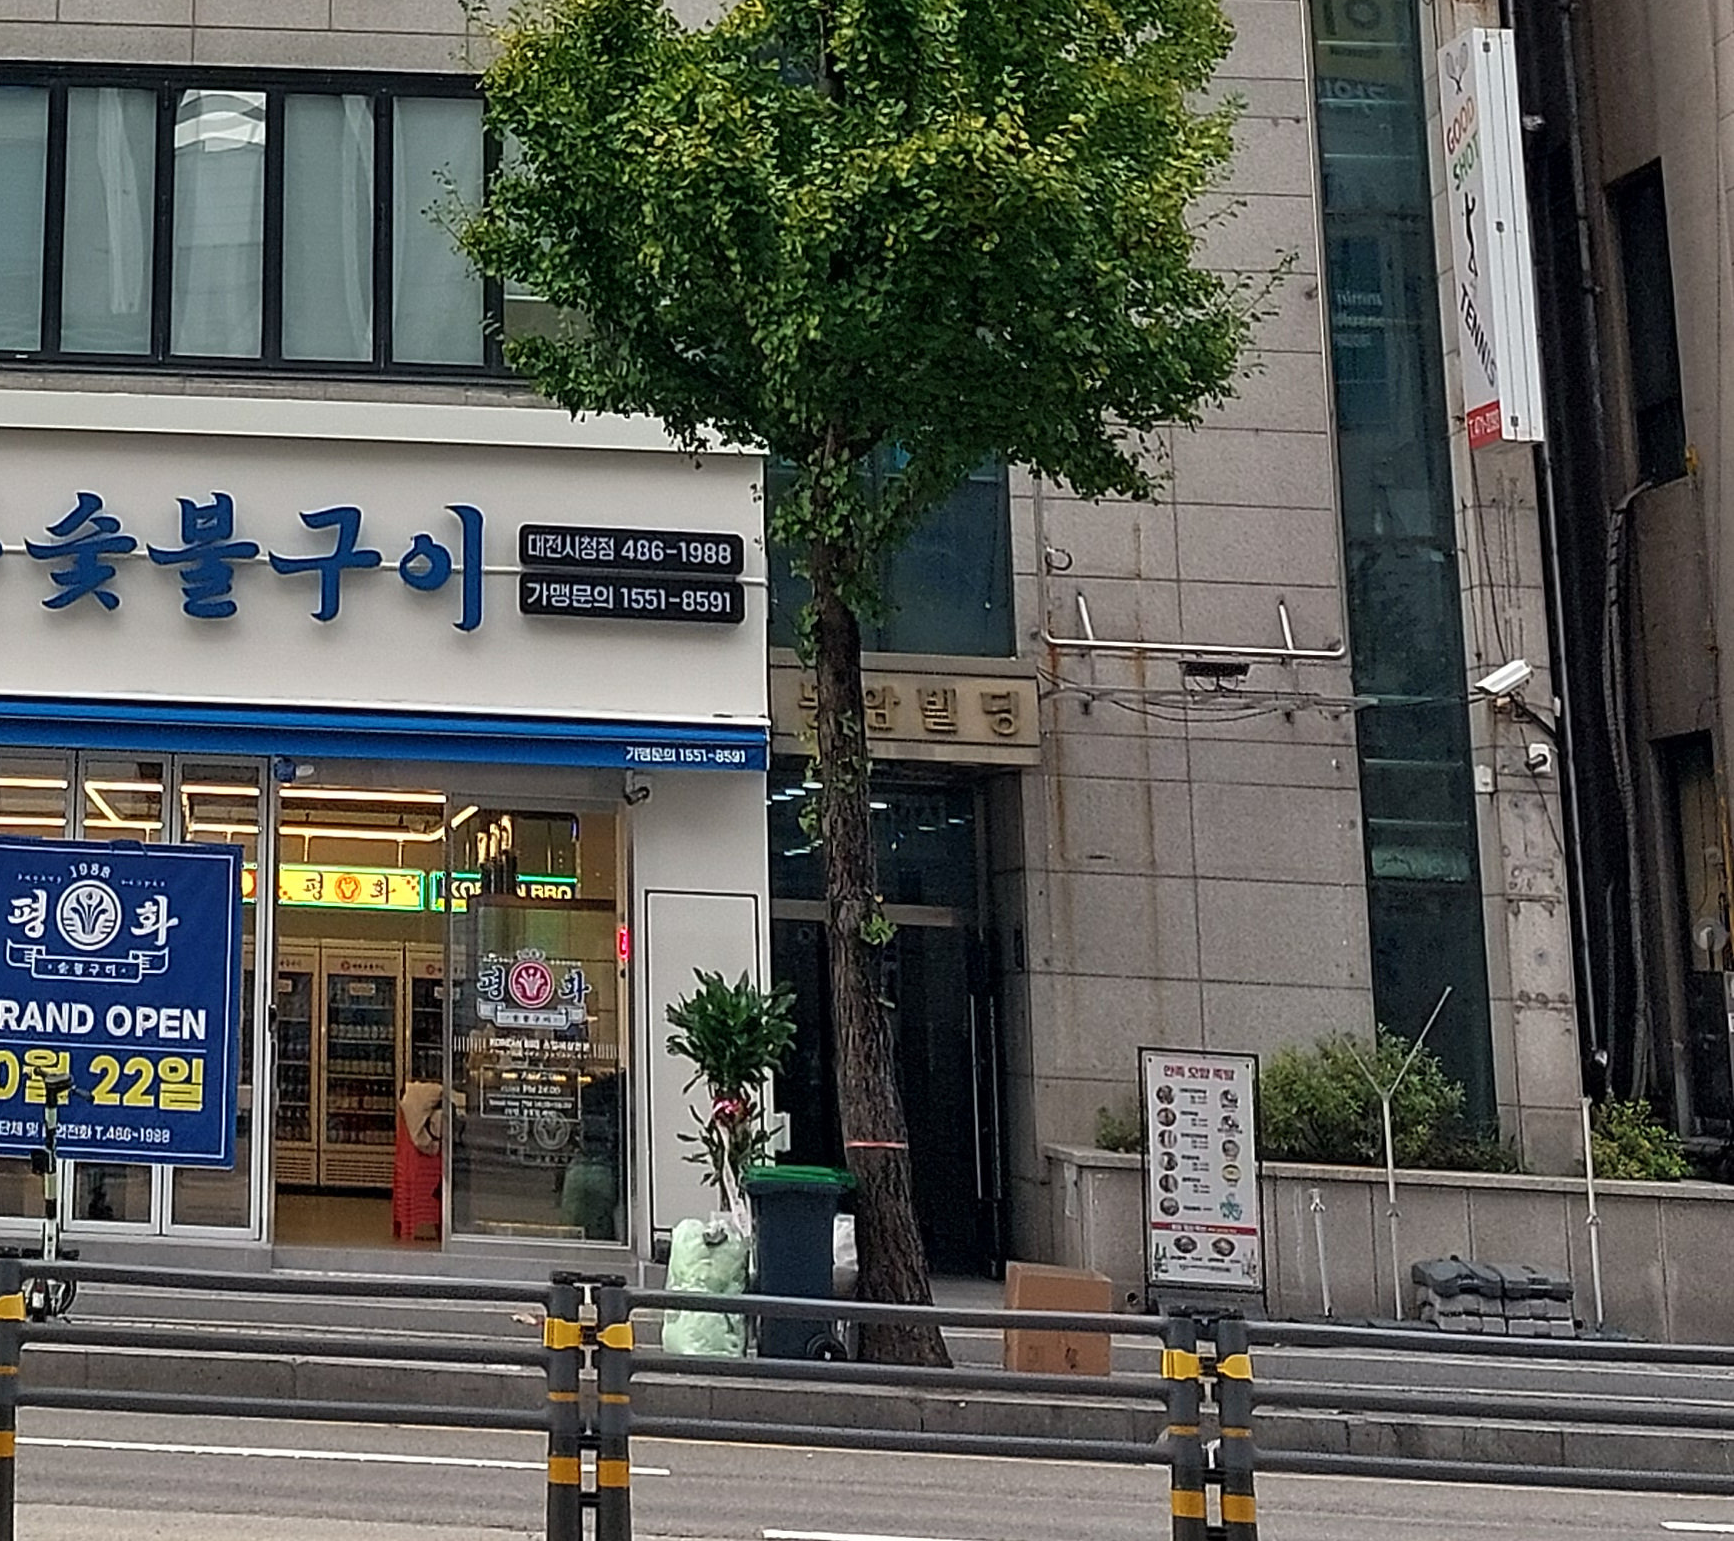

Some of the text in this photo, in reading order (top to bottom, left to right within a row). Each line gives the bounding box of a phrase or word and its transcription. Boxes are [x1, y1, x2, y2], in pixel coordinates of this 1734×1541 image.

[1446, 95, 1475, 156] GOOD
[1453, 131, 1480, 192] SHOT
[1458, 282, 1499, 389] TENNIS
[23, 489, 485, 634] 숯불구이
[527, 533, 732, 565] 대전시청점 486-1988
[526, 582, 732, 614] 가맹문의 1551-8591
[104, 1003, 207, 1042] OPEN
[89, 1053, 205, 1113] 22일
